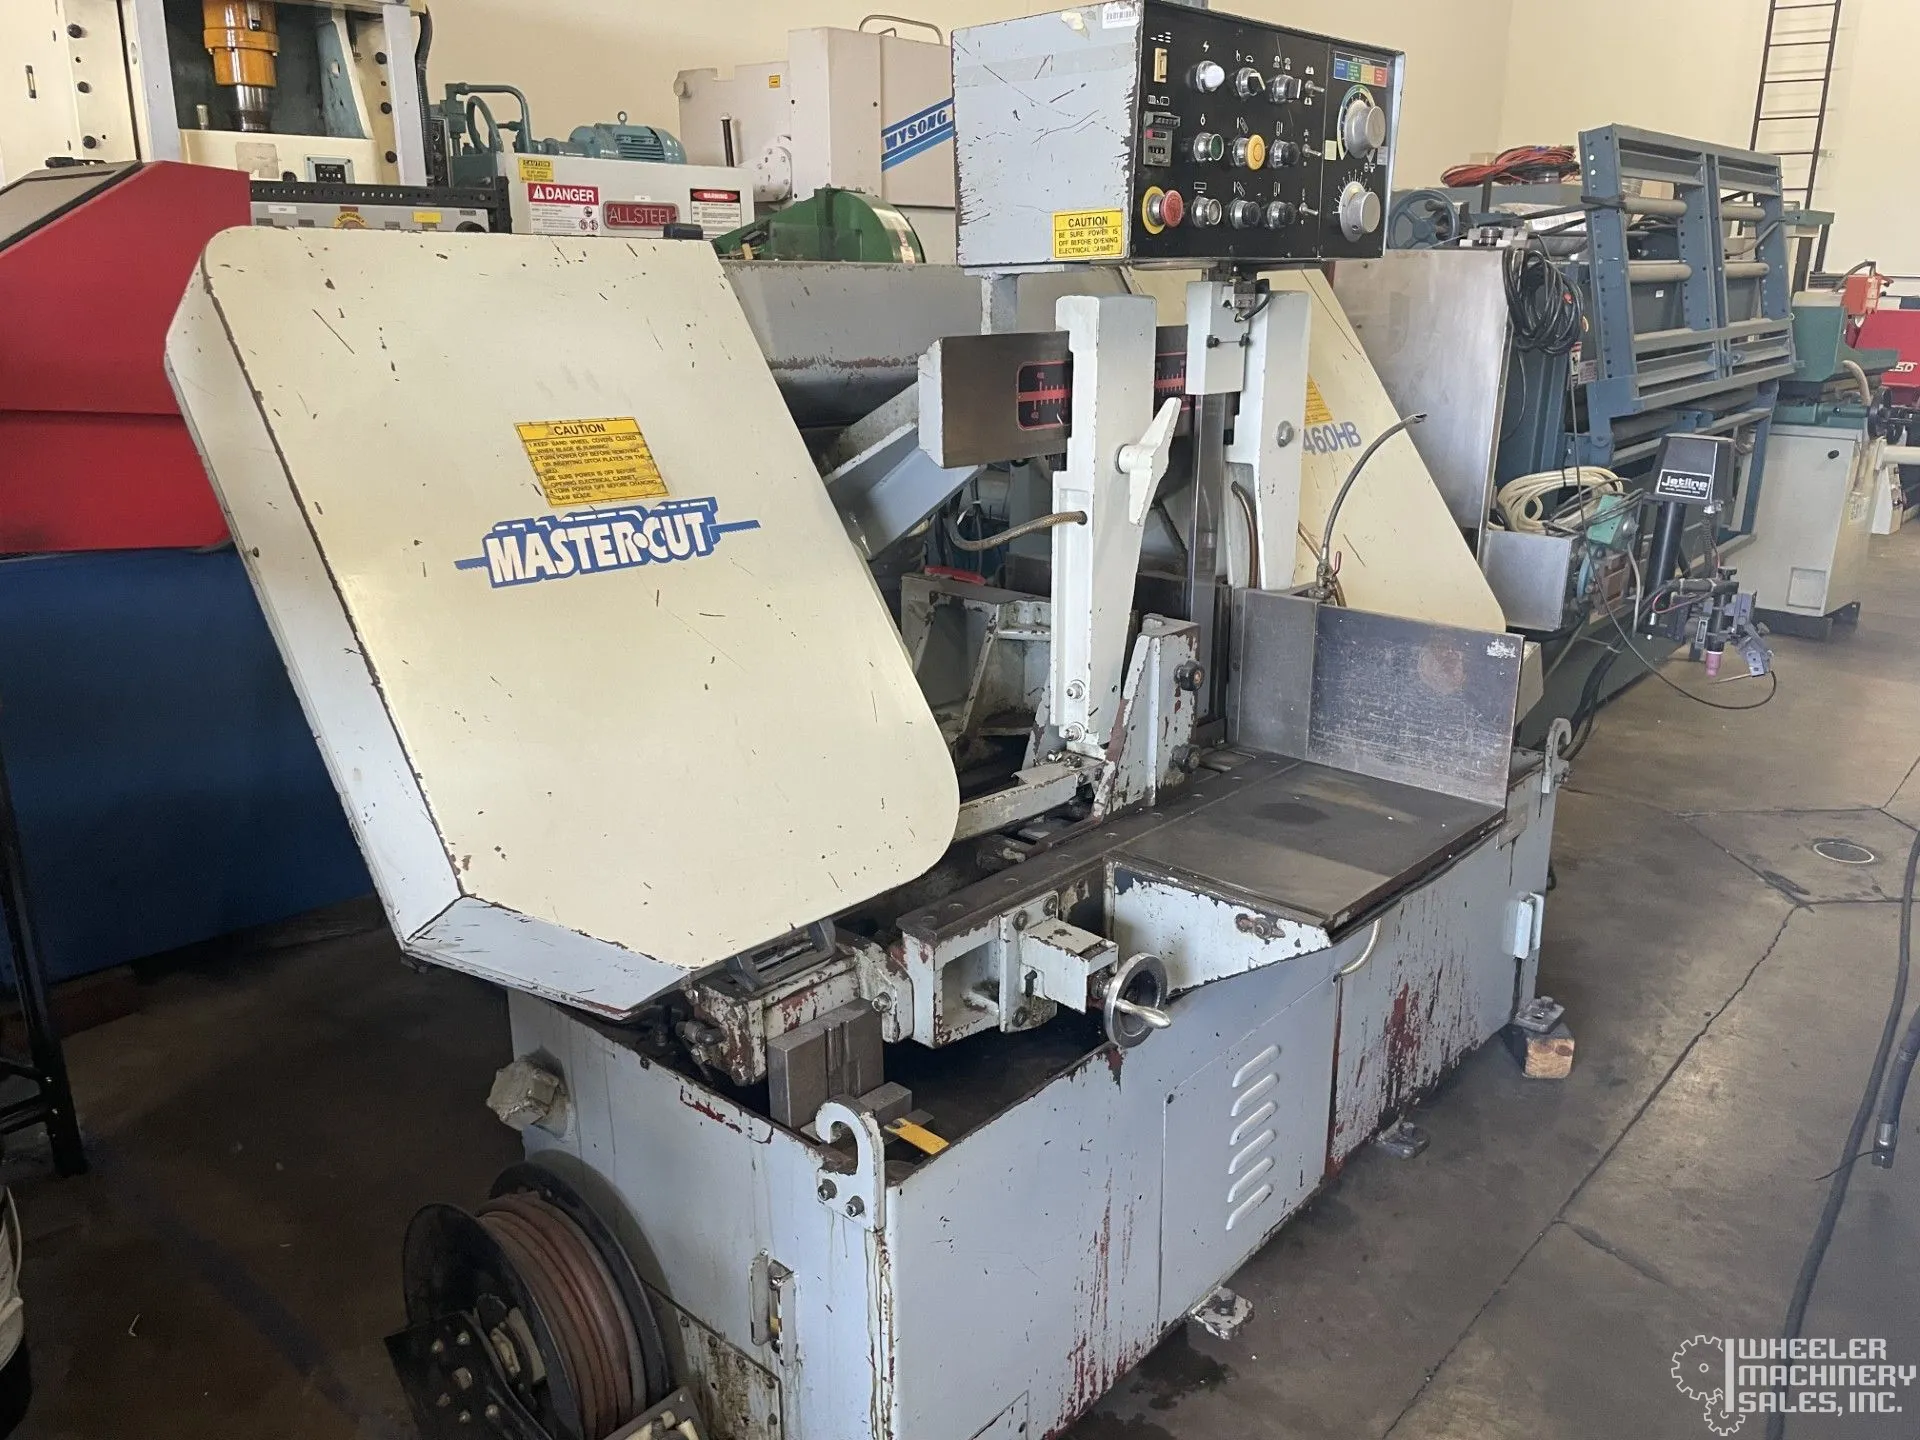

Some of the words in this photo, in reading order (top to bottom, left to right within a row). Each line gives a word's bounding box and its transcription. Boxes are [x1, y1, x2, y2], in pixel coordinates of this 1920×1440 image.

[884, 109, 947, 151] WYSONG
[545, 187, 594, 202] DANGER
[609, 207, 672, 225] ALLSTEEL
[1068, 216, 1108, 228] CAUTION
[1059, 247, 1091, 255] ELECTRICAL
[554, 423, 605, 436] CAUTION
[578, 477, 610, 485] ELECTRICAL
[1661, 475, 1707, 492] Jetline
